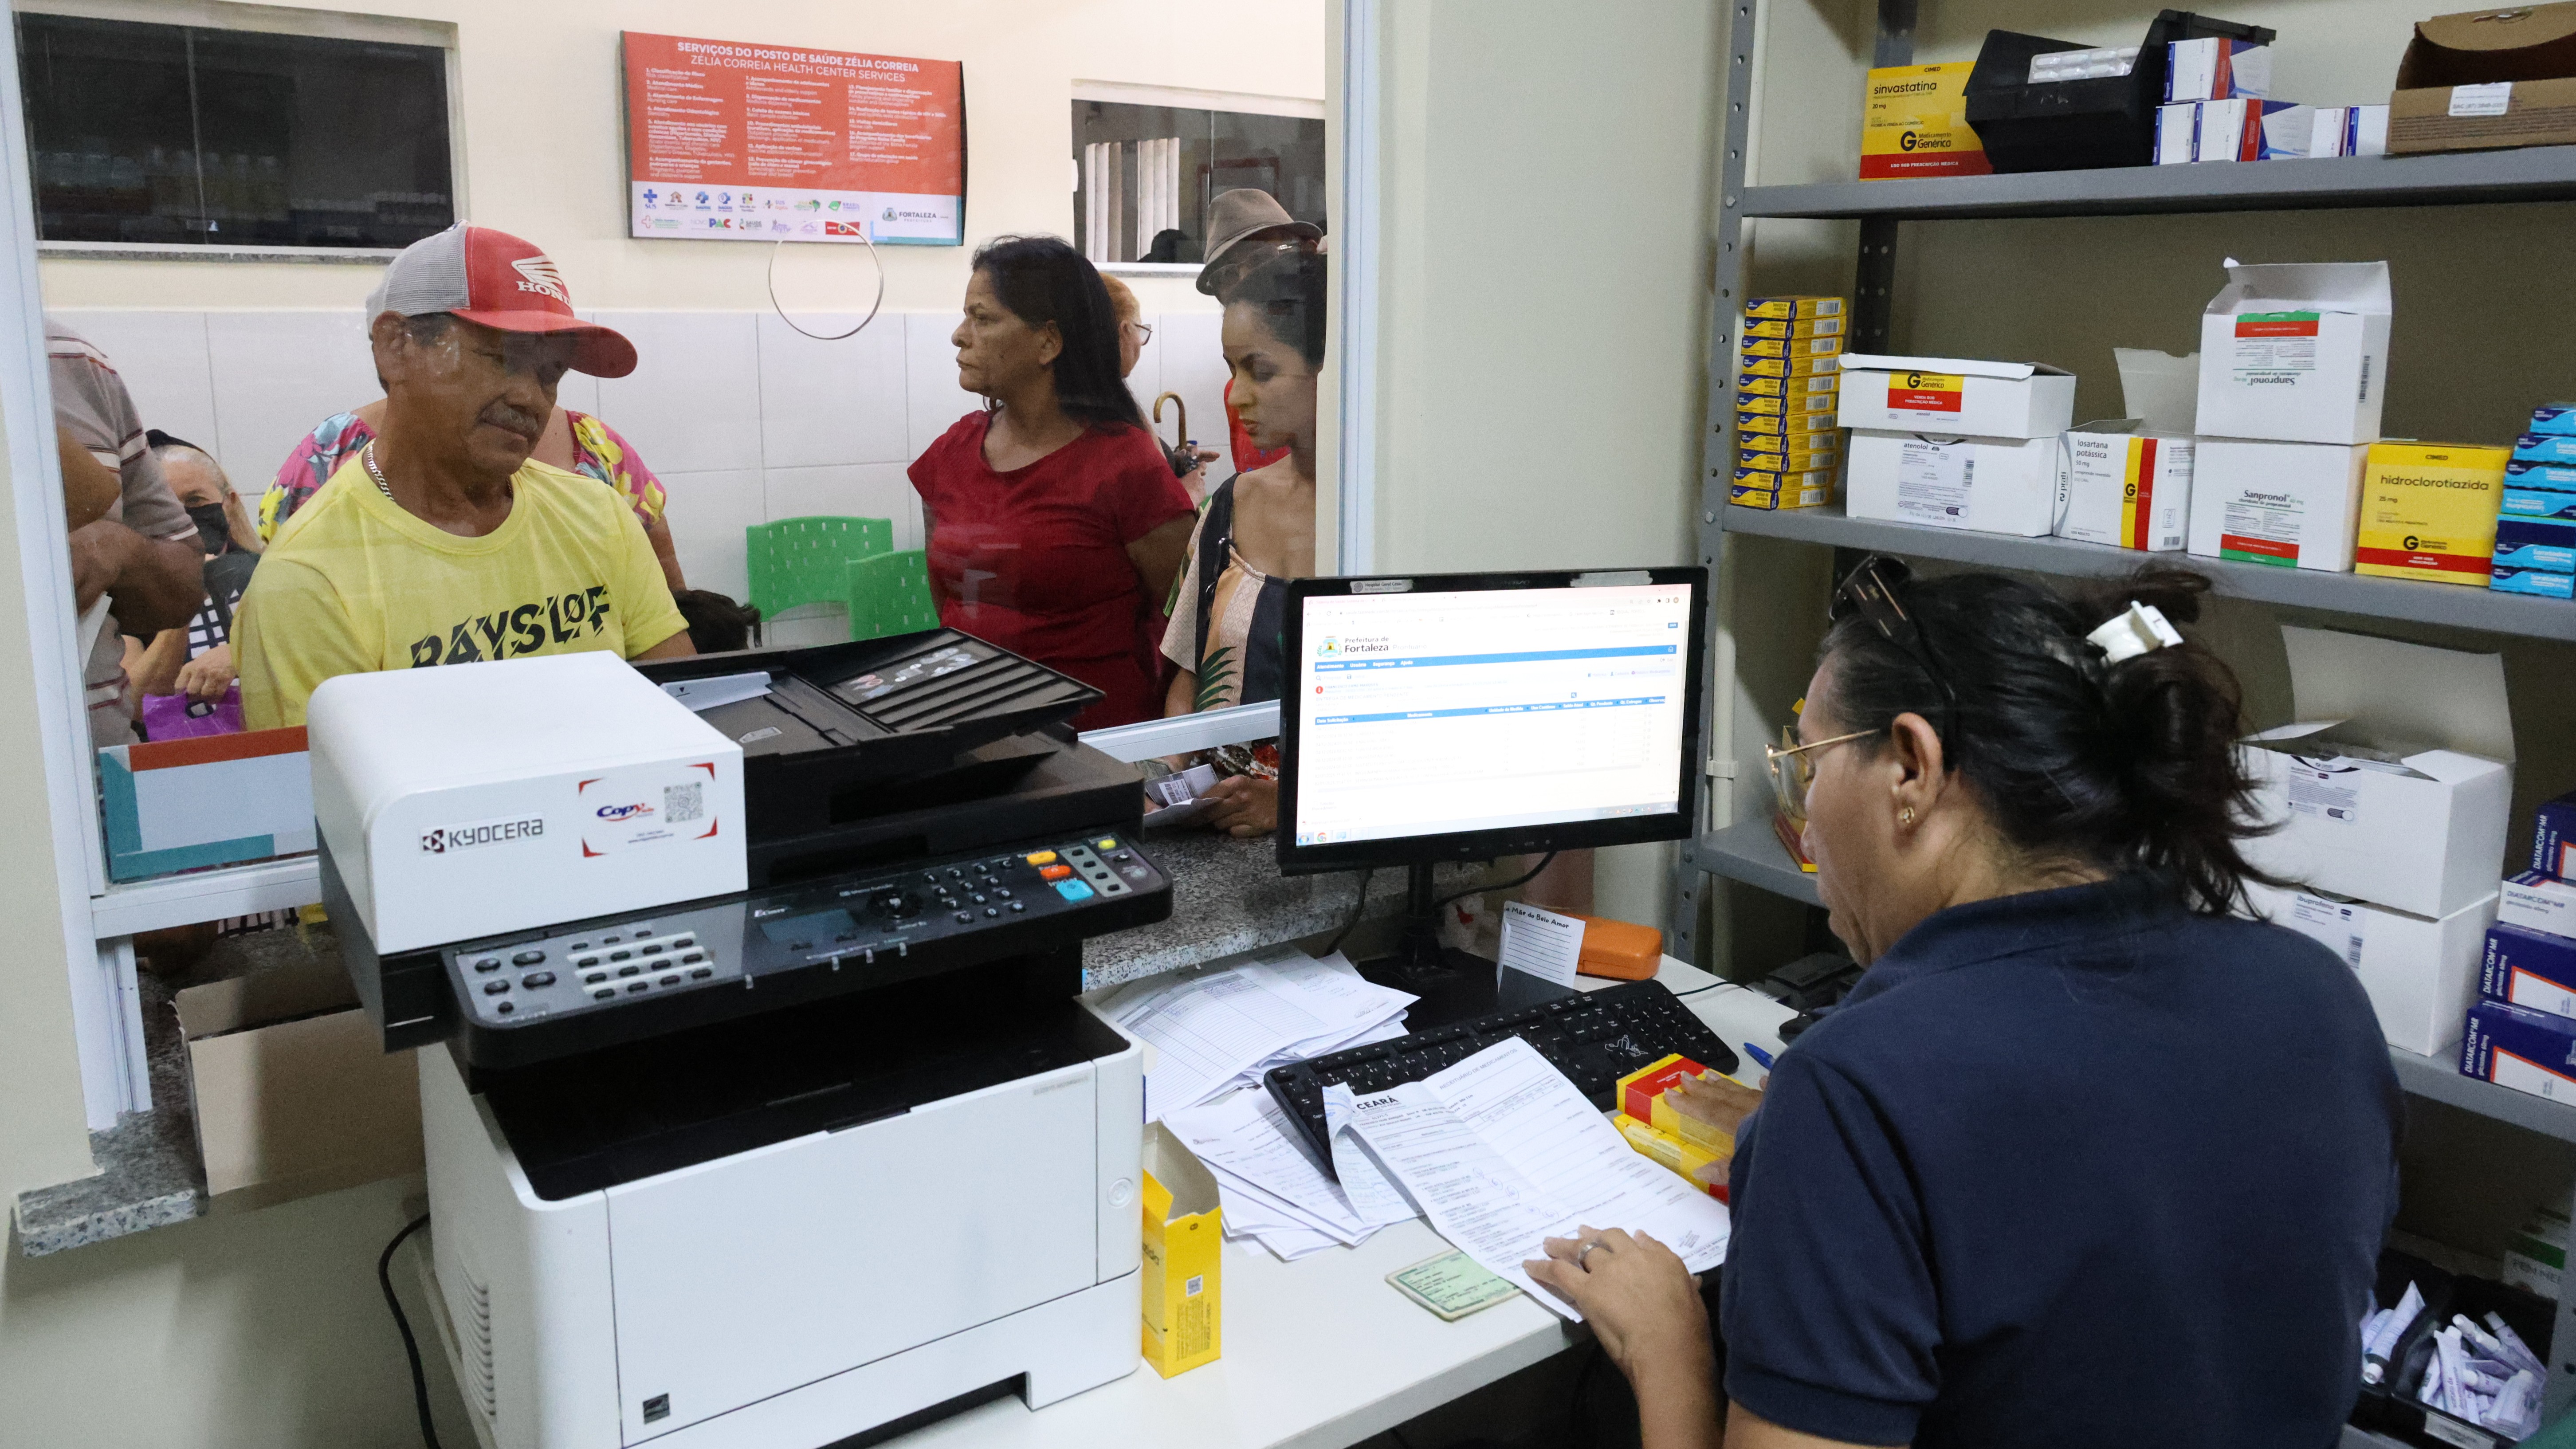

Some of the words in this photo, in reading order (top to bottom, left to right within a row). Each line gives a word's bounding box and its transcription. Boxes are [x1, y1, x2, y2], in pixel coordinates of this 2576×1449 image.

[678, 42, 732, 56] SERVIÇOS
[735, 47, 752, 57] DO
[754, 49, 790, 60] POSTO
[793, 53, 806, 62] DE
[809, 53, 843, 66] SAÚDE
[845, 56, 873, 68] ZÉLIA
[875, 60, 919, 72] CORREIA
[691, 54, 721, 66] ZÉLIA
[724, 58, 771, 71] CORREIA
[774, 63, 813, 74] HEALTH
[816, 66, 856, 78] CENTER
[859, 70, 906, 82] SERVICES
[1874, 81, 1937, 94] sinvastatina
[1918, 138, 1951, 148] Genérico
[709, 218, 731, 228] PAC
[2077, 439, 2108, 448] losartana
[2076, 450, 2107, 459] potássica
[2380, 475, 2489, 490] hidroclorotiazida
[1345, 644, 1389, 652] Fortaleza
[2539, 814, 2548, 826] MR
[449, 818, 543, 848] KYOCERA
[2297, 895, 2334, 910] ibuprofeno
[1536, 914, 1549, 923] Belo
[1551, 919, 1569, 929] Amor
[2489, 938, 2498, 950] MR
[2470, 1017, 2479, 1031] MR
[1440, 1070, 1473, 1090] RECEITUÁRIO
[1480, 1048, 1518, 1070] MEDICAMENTOS
[1356, 1095, 1398, 1110] CEARÁ
